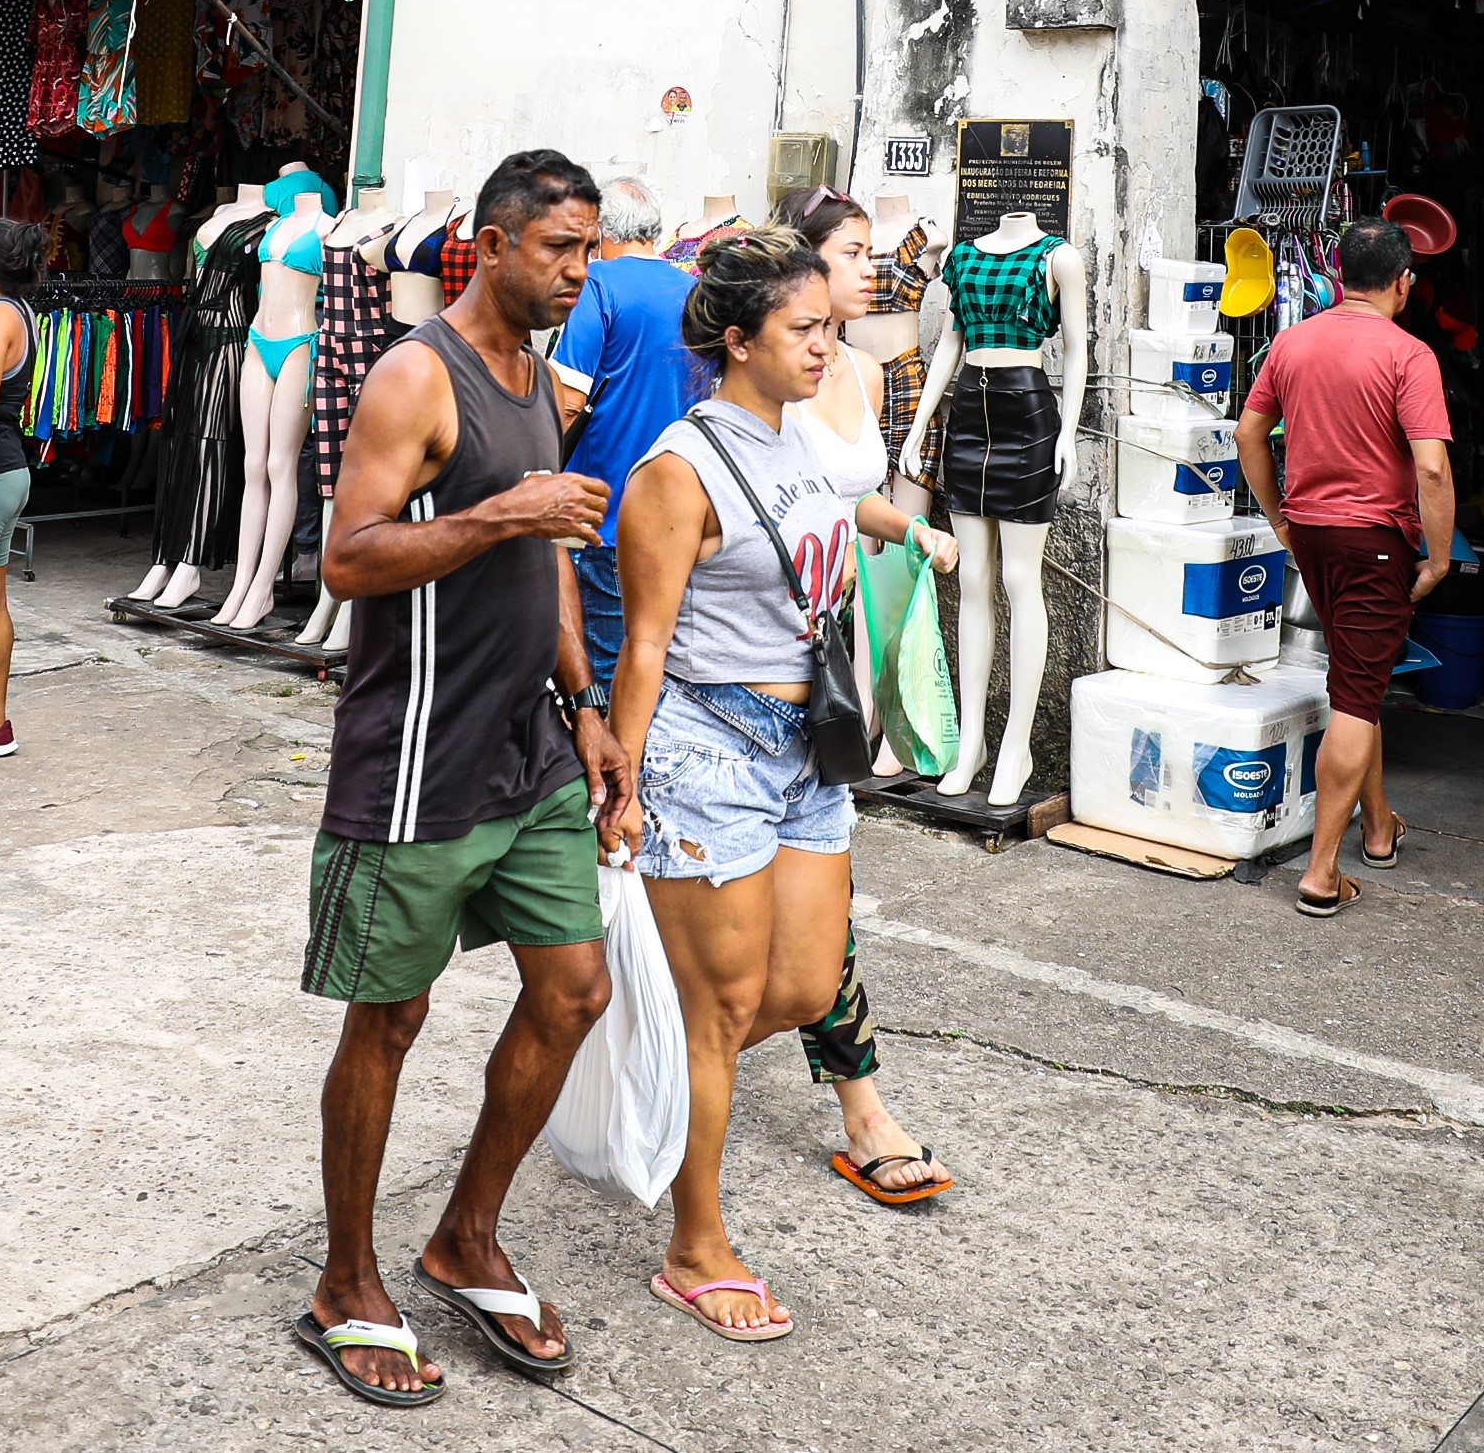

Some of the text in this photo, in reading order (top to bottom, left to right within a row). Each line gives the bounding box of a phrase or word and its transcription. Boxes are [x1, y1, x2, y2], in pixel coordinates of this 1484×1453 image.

[890, 142, 924, 171] 1333
[962, 179, 976, 187] DOS
[978, 179, 1017, 188] MERCADOS
[1242, 573, 1263, 585] ISOESTE
[1231, 768, 1268, 780] ISOESTE
